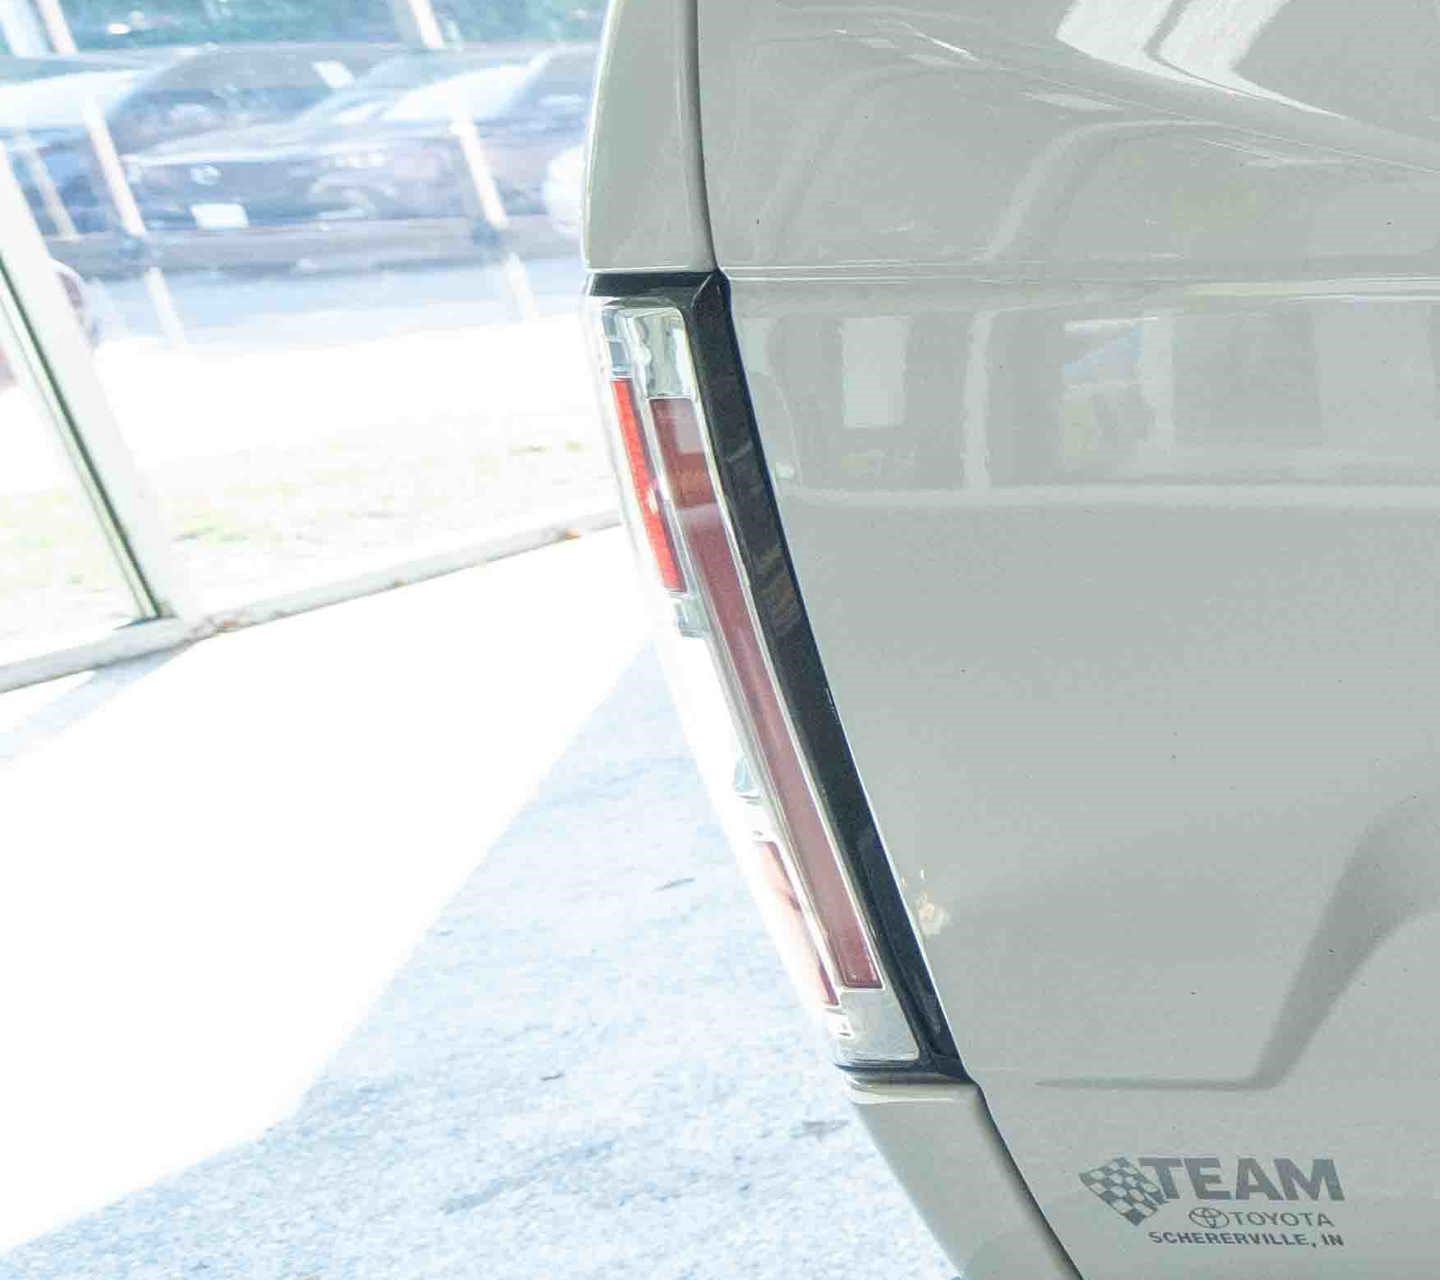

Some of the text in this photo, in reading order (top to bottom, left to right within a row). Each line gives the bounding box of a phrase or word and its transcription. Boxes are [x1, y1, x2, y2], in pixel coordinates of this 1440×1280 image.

[1138, 1156, 1346, 1202] TEAM
[1231, 1210, 1336, 1228] TOYOTA
[1149, 1231, 1345, 1249] SCHERERVILLE, IN
